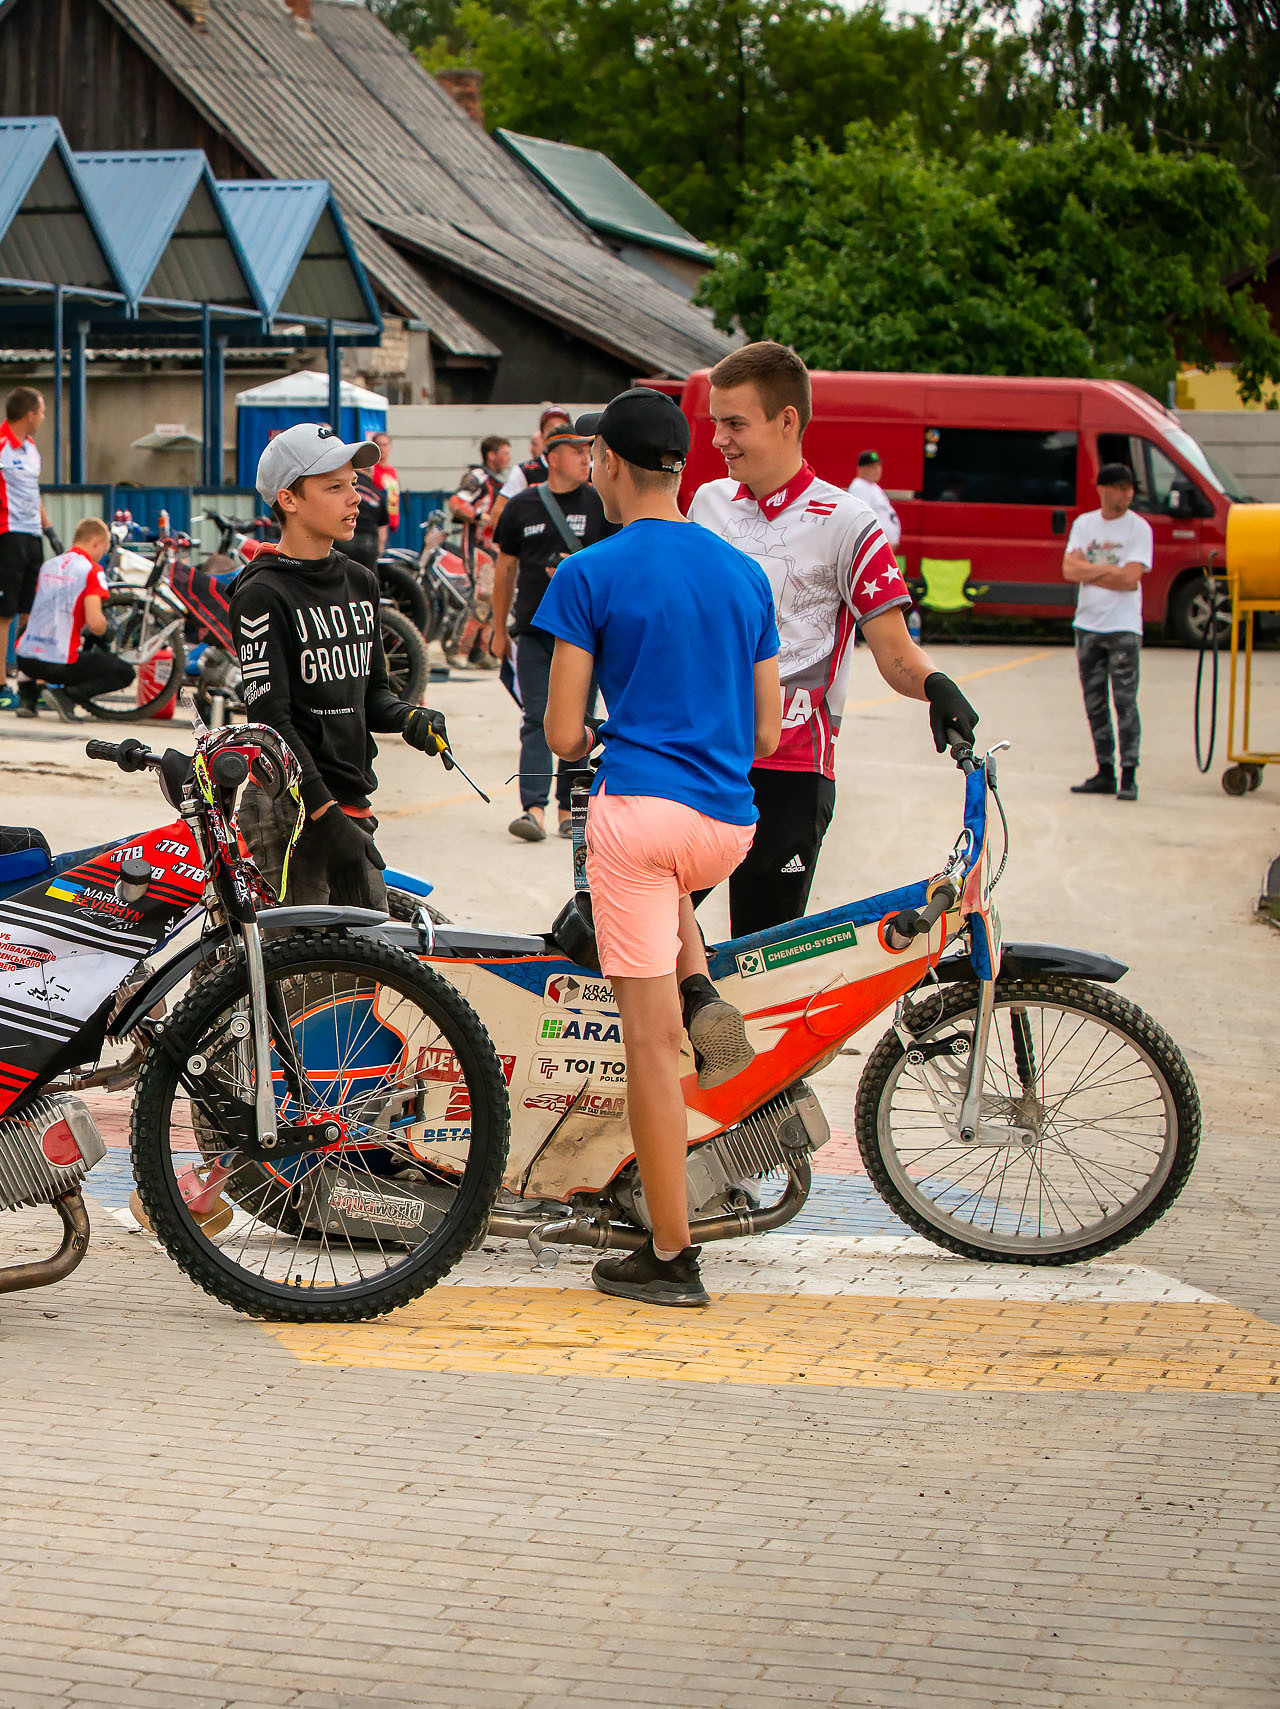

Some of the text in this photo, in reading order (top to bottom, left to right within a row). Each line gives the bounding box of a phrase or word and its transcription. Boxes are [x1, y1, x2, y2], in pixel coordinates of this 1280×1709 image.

[799, 513, 829, 526] LAT
[155, 839, 190, 858] #778
[171, 862, 206, 883] #778
[781, 865, 805, 873] adidas
[73, 892, 144, 922] LEVISHYN
[584, 984, 614, 995] KRAJ
[564, 1059, 595, 1074] TOI
